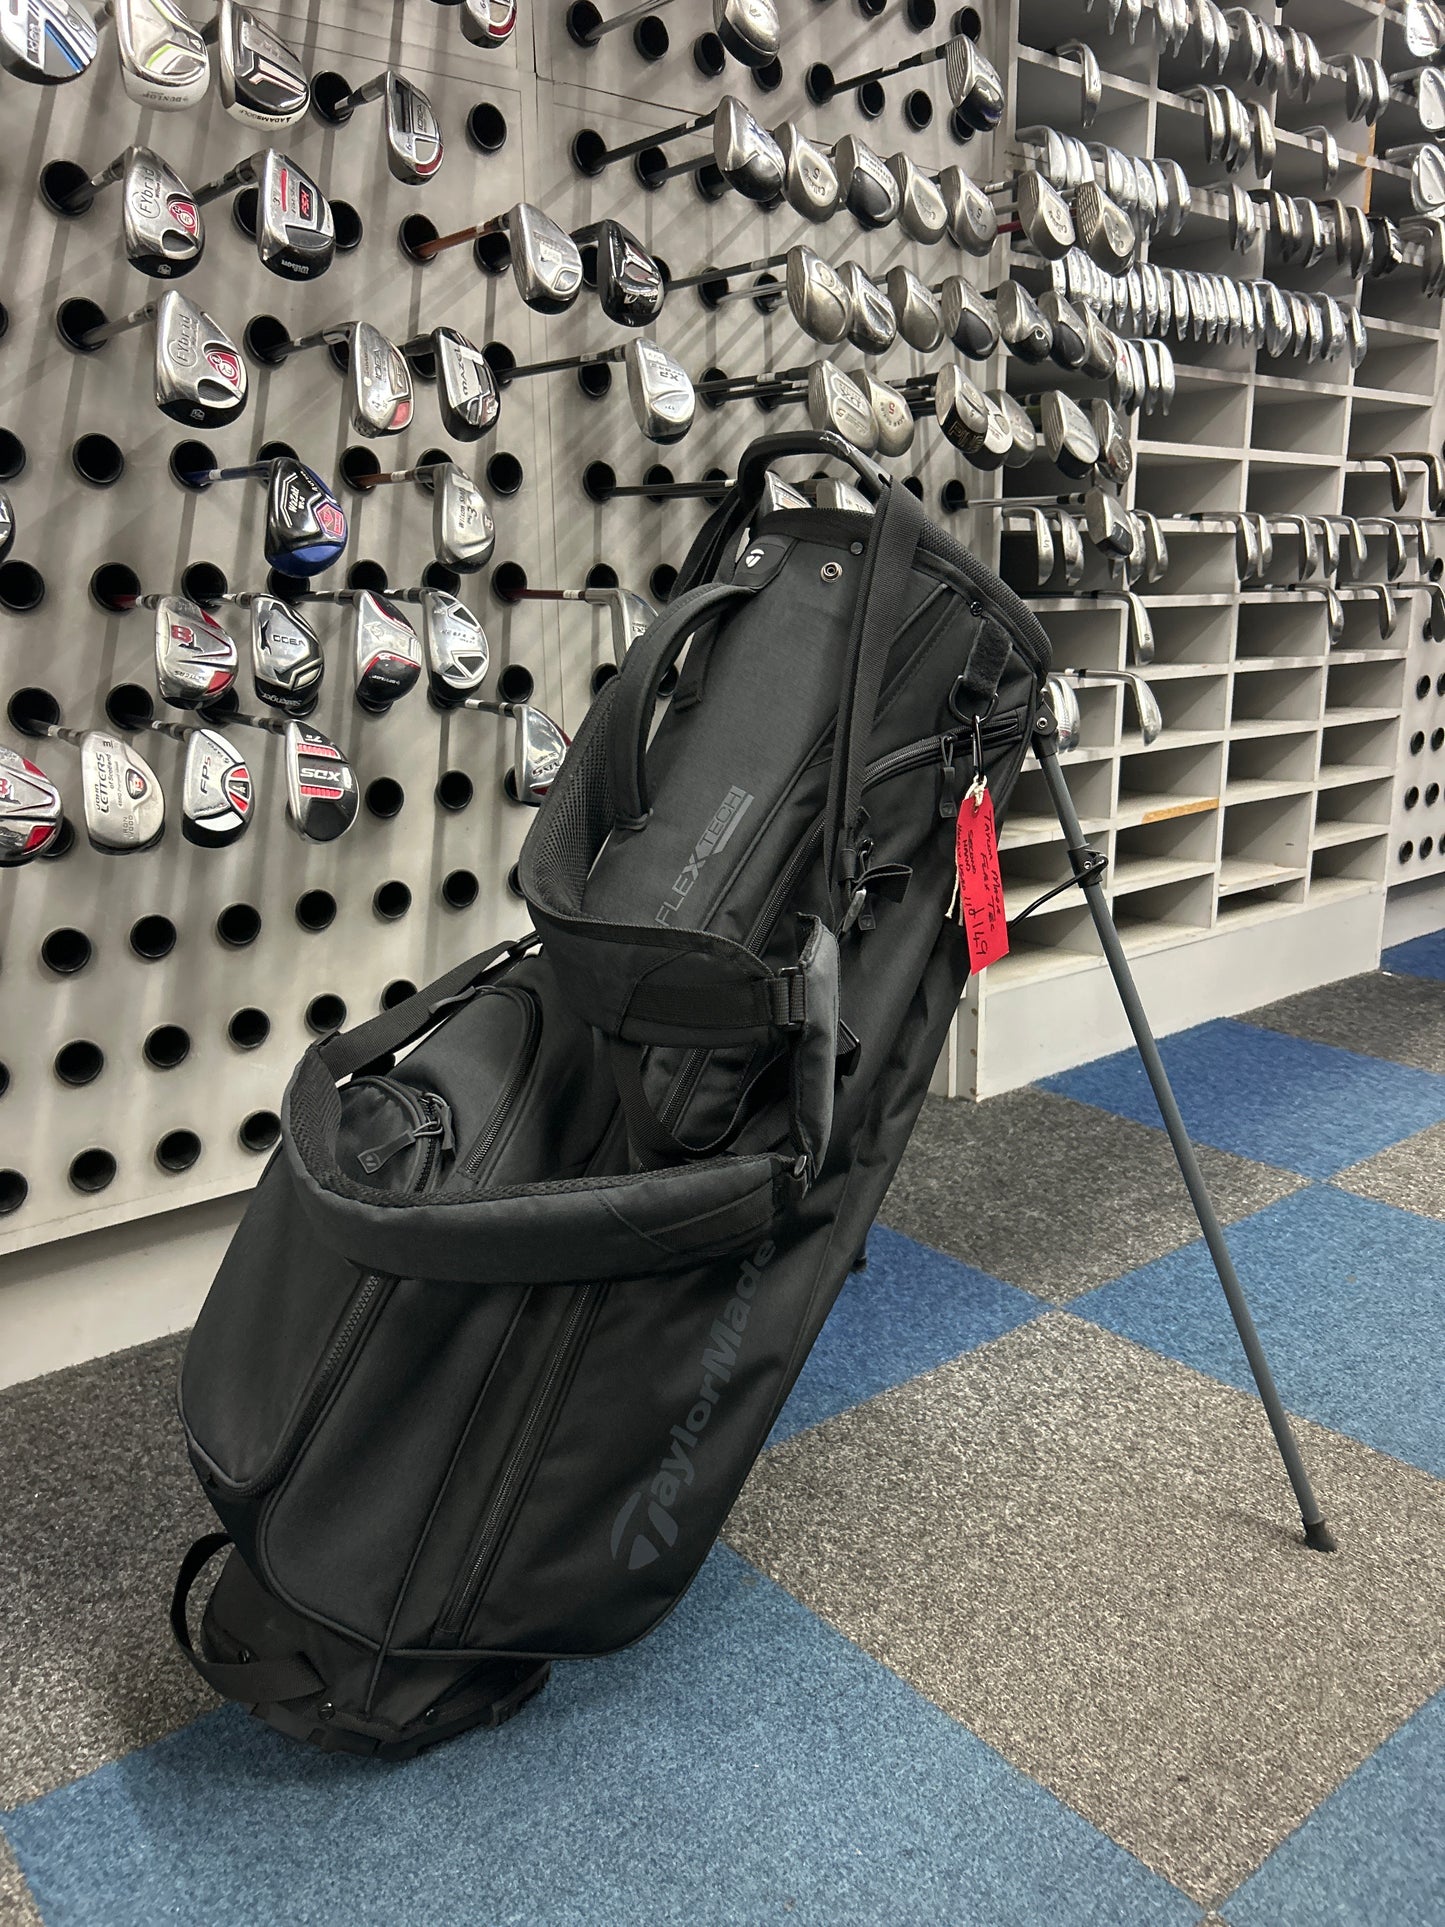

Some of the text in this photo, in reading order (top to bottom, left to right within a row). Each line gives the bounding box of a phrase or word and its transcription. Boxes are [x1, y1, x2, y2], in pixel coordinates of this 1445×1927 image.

[143, 91, 182, 103] DUNLOP
[139, 166, 156, 215] FYbrid
[281, 259, 309, 275] Wilson
[177, 314, 192, 363] FYbrid
[262, 692, 302, 707] Slazenger
[101, 752, 111, 813] LETTERS
[107, 753, 115, 781] Scotland
[967, 828, 977, 875] SECOND
[980, 852, 990, 892] FLEX
[610, 1239, 777, 1571] TaylorMade
